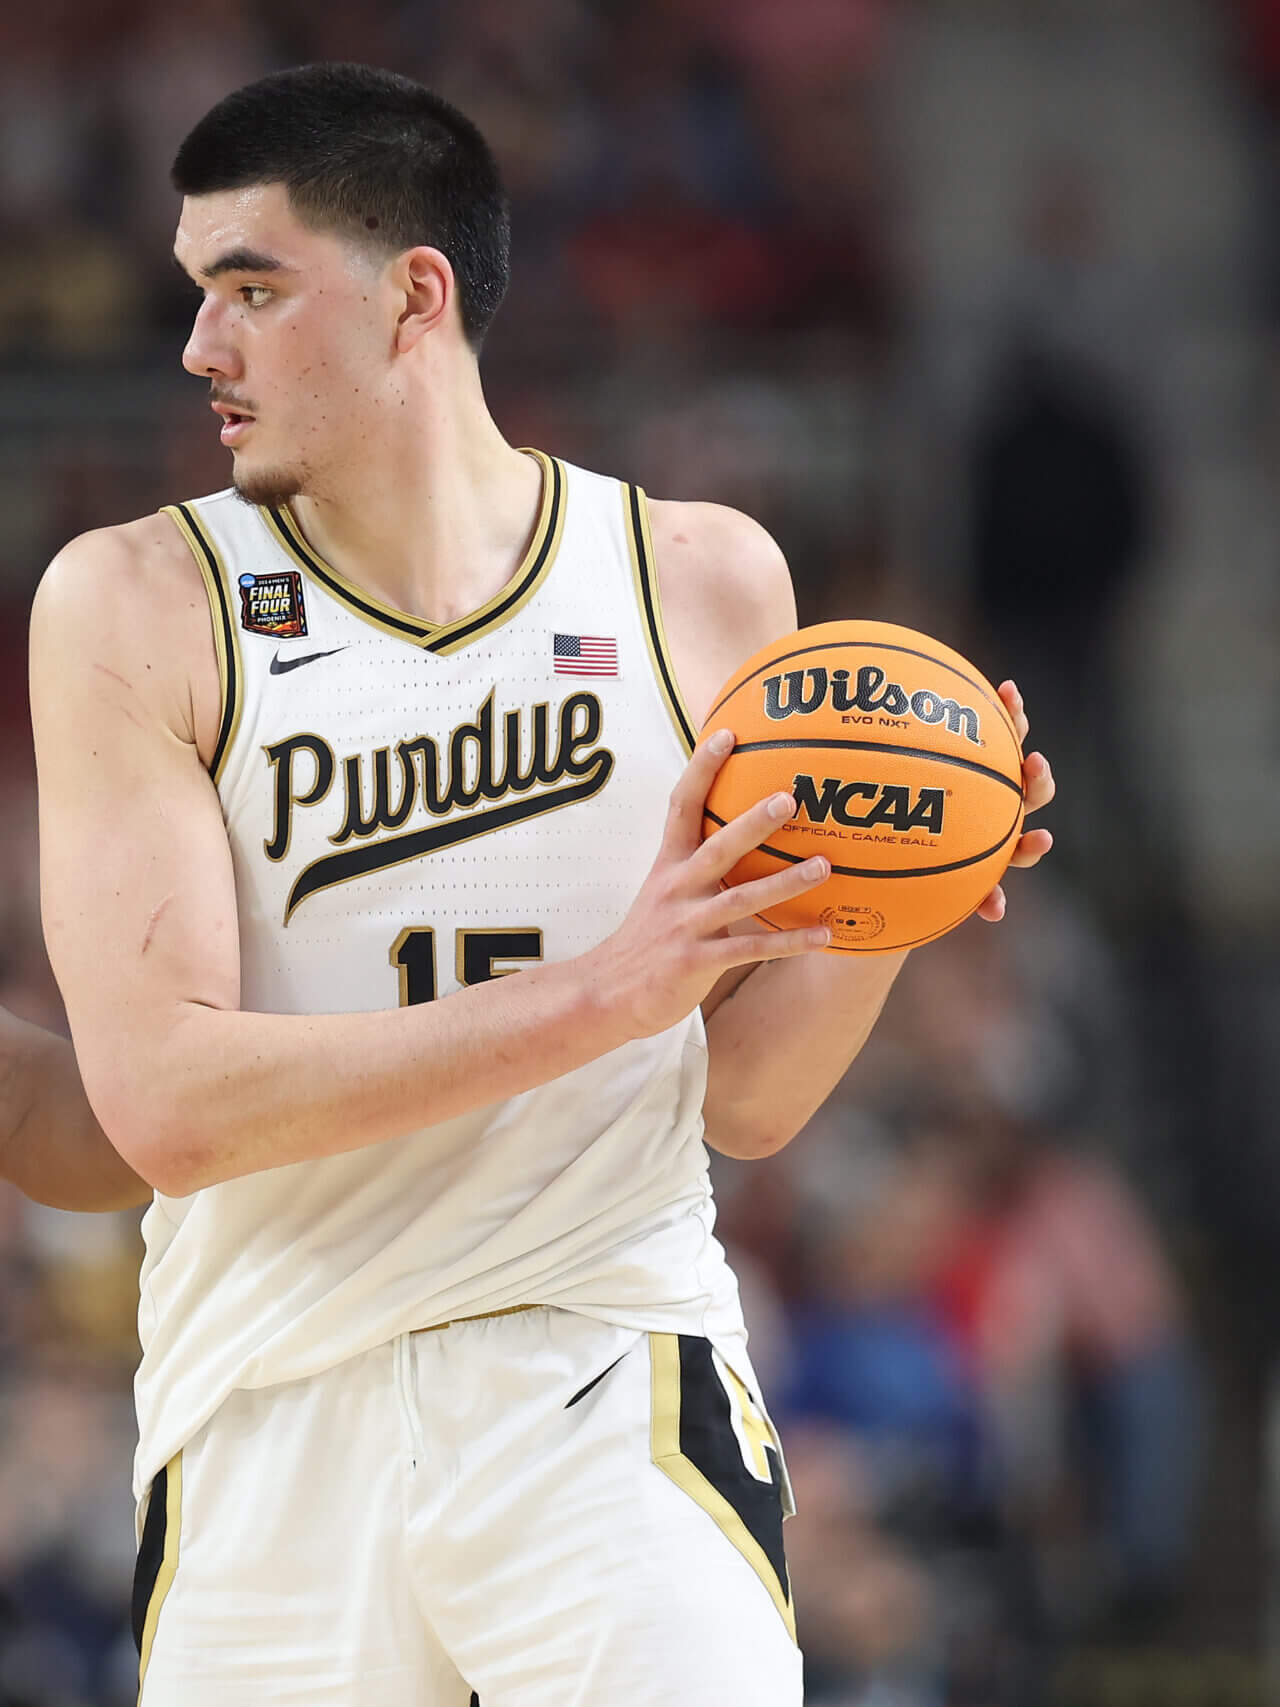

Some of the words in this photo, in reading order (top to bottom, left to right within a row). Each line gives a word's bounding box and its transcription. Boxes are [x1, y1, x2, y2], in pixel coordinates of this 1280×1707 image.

[249, 584, 290, 600] FINAL
[250, 598, 290, 614] FOUR
[762, 665, 980, 746] Wilson
[841, 715, 873, 725] EVO
[879, 718, 910, 730] NXT
[261, 685, 615, 862] Purdue
[792, 773, 945, 836] NCAA
[782, 823, 848, 839] OFFICIAL
[852, 832, 897, 844] GAME
[900, 838, 937, 847] BALL
